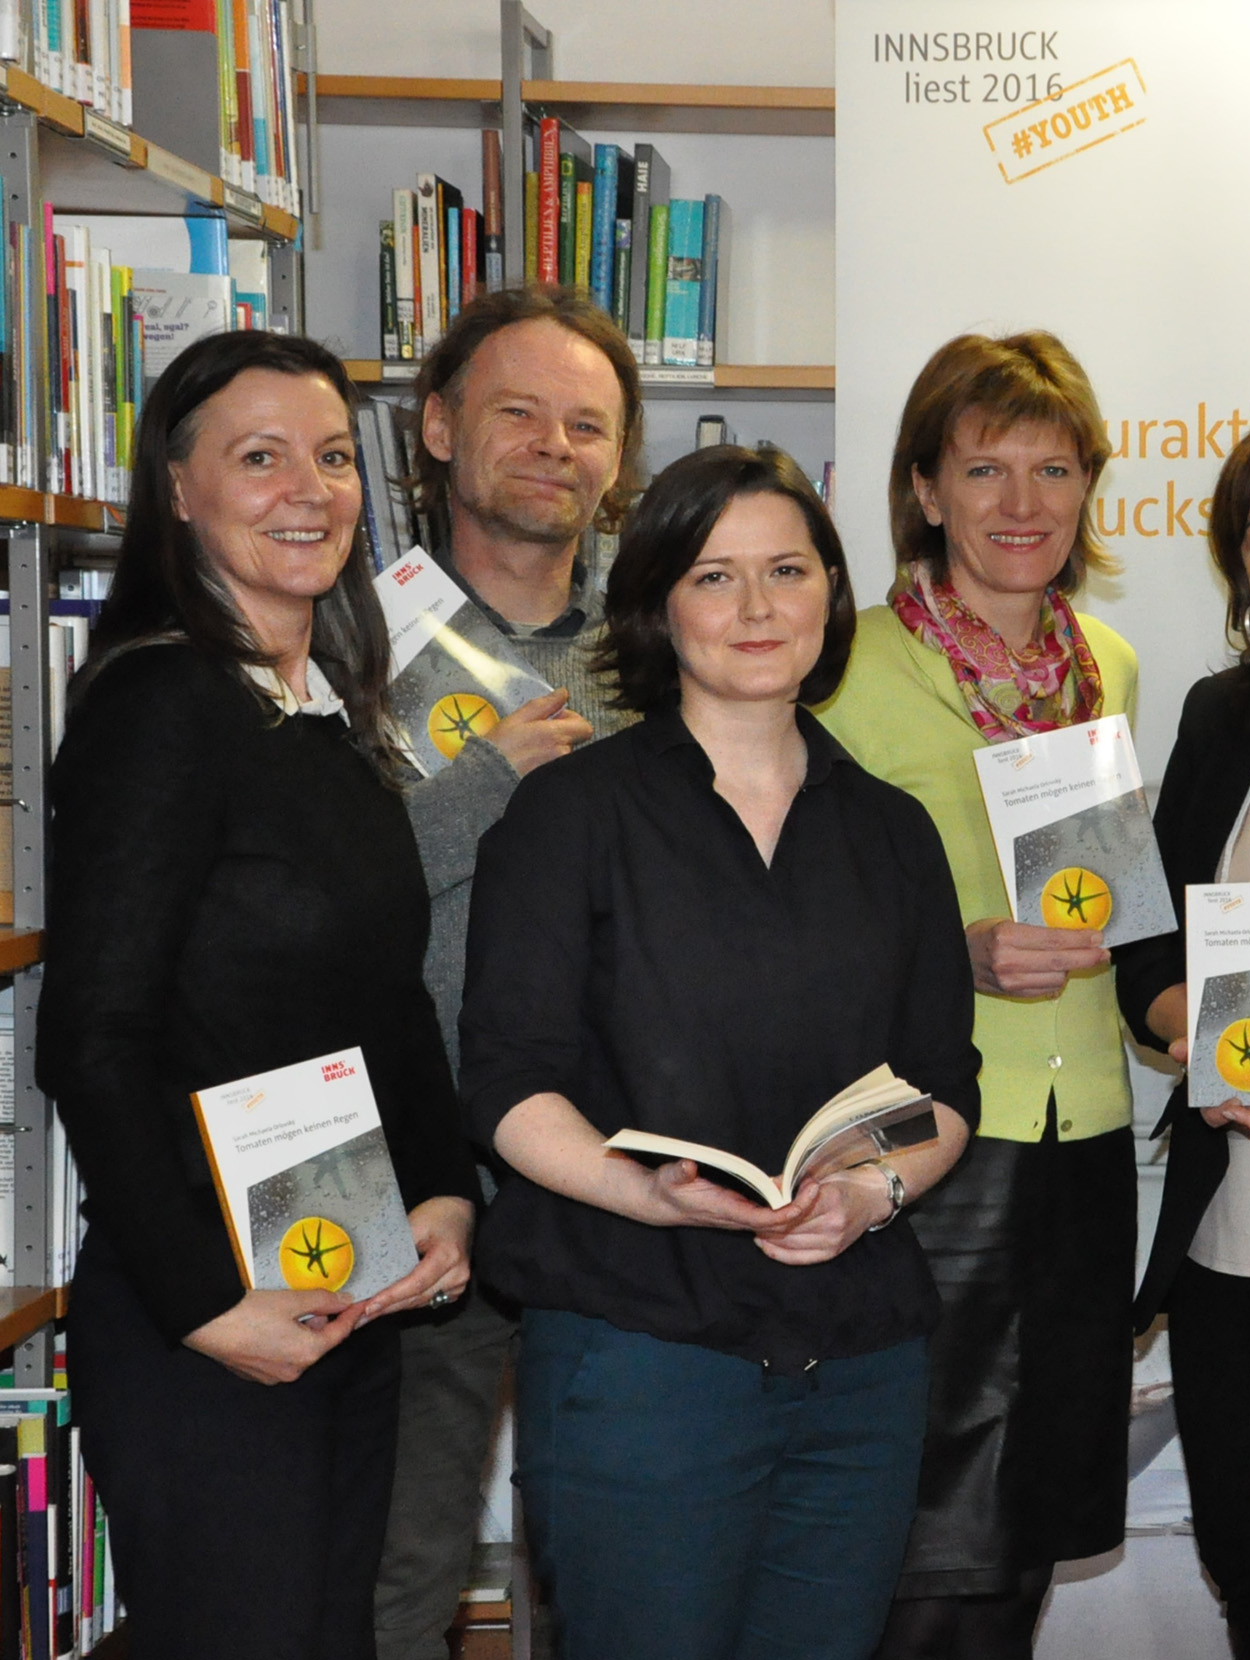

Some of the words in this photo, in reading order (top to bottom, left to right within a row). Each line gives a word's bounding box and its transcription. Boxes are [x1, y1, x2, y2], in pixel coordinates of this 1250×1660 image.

[874, 30, 1059, 63] INNSBRUCK
[905, 71, 971, 104] liest
[982, 72, 1064, 103] 2016
[1010, 82, 1135, 159] #YOUTH
[637, 161, 648, 192] HAIE
[397, 564, 424, 586] BRUCK
[423, 597, 445, 613] egen
[1004, 794, 1039, 807] Tomaten
[1040, 786, 1069, 800] mögen
[1069, 779, 1096, 792] keinen
[1205, 938, 1239, 947] Tomaten
[323, 1066, 356, 1083] BRUCK
[235, 1135, 273, 1154] Tomaten
[274, 1128, 303, 1144] mögen
[304, 1120, 332, 1133] keinen
[334, 1111, 359, 1127] Regen
